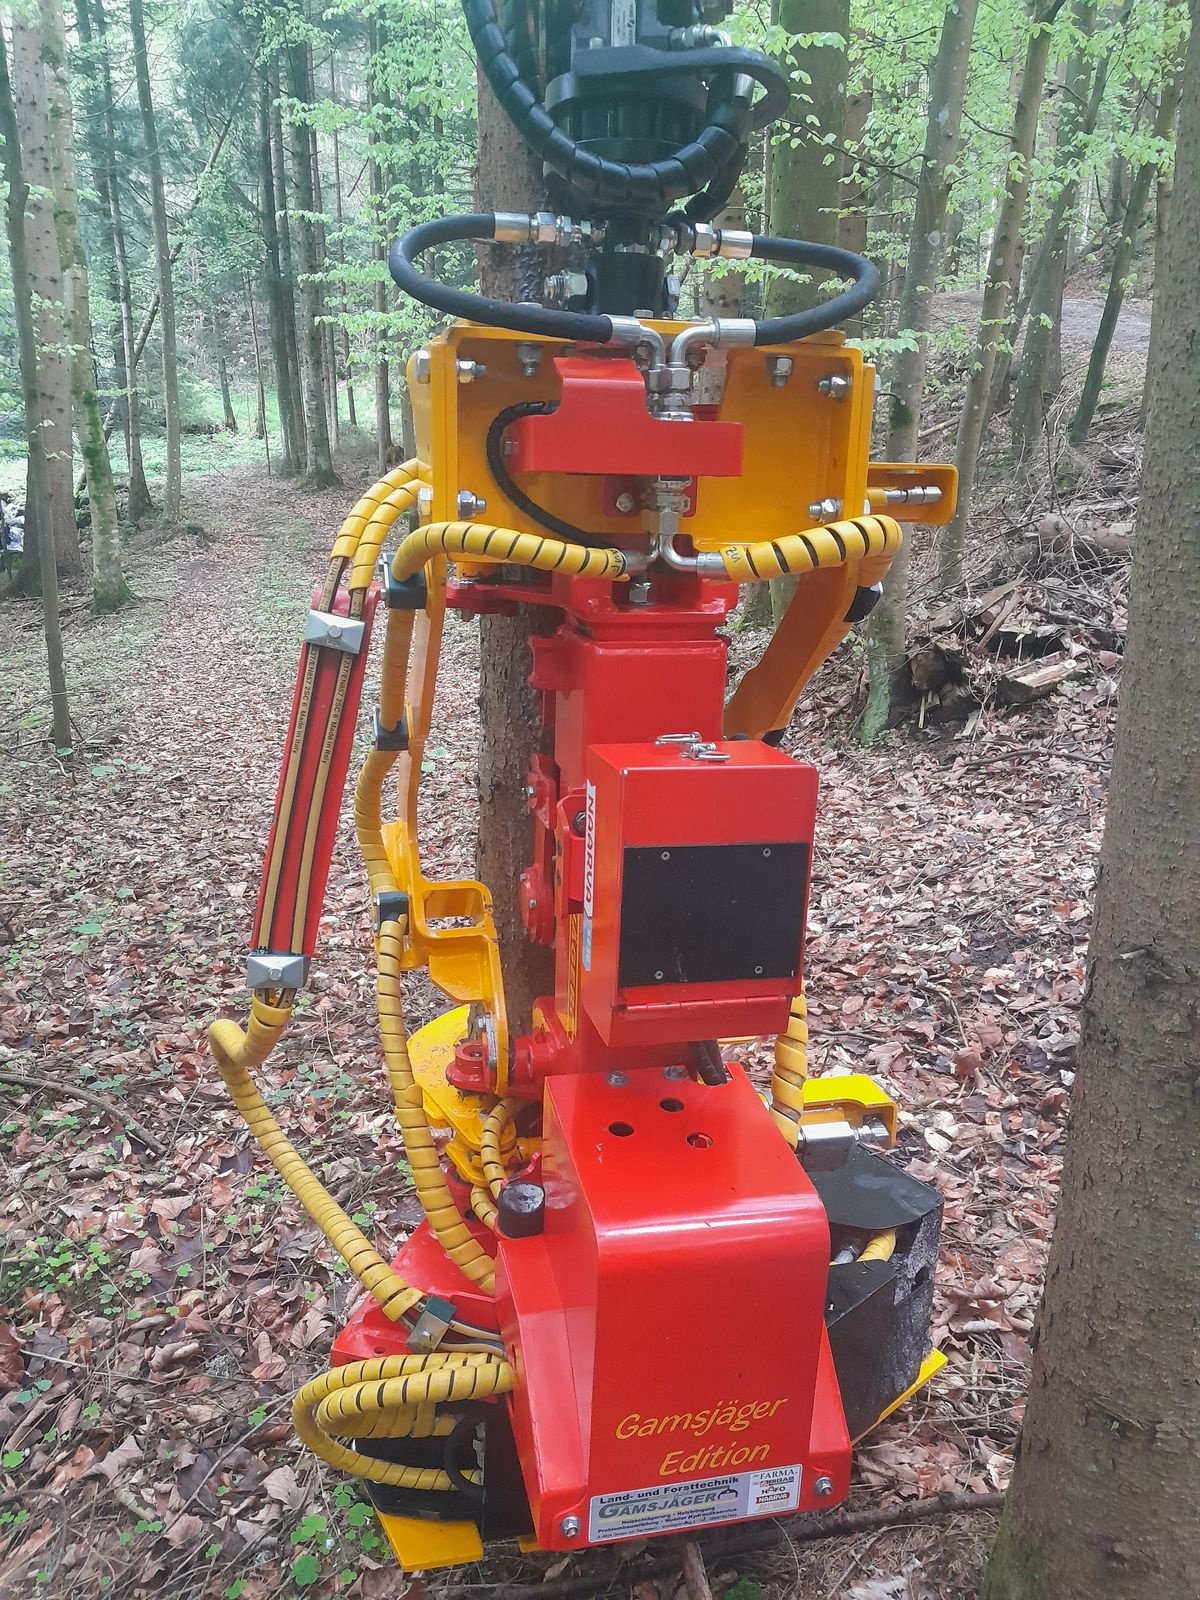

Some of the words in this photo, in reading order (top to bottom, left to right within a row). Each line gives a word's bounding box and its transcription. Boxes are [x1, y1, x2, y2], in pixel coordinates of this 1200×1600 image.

[298, 711, 306, 730] Made
[296, 730, 301, 738] in
[328, 721, 337, 741] Made
[292, 739, 301, 754] Italy
[321, 749, 331, 765] Italy
[585, 795, 594, 904] NAARVA
[615, 1398, 788, 1440] Gamsjäger
[658, 1441, 770, 1476] Edition
[760, 1469, 794, 1480] FARMA
[600, 1494, 633, 1504] Land-
[639, 1489, 660, 1498] und
[664, 1477, 739, 1494] Forsttechnik
